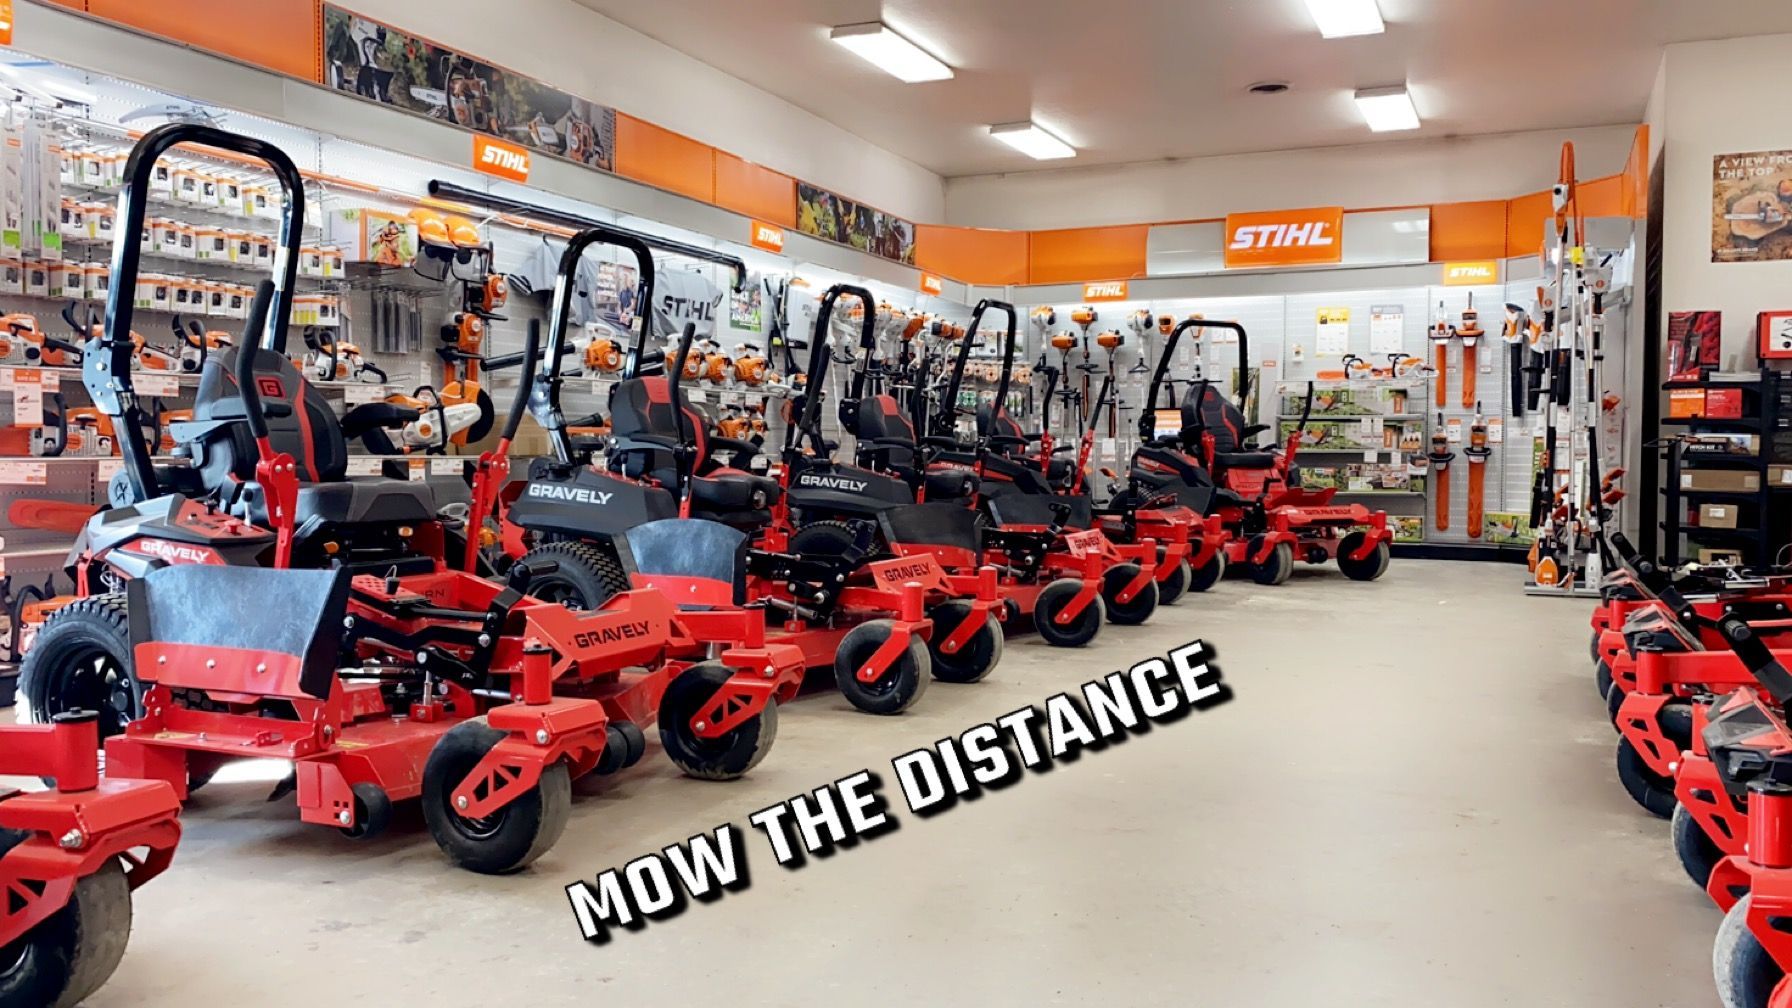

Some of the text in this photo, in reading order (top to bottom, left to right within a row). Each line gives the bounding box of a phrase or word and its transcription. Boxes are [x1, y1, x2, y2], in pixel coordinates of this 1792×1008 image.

[482, 145, 529, 174] STIHL
[1719, 160, 1728, 169] A
[1731, 156, 1766, 168] VIEW
[1718, 167, 1774, 179] THE TOP
[757, 227, 784, 246] STIHL
[1229, 222, 1333, 250] STIHL
[1449, 266, 1491, 278] STIHL
[1086, 283, 1125, 297] STIHL
[661, 296, 714, 321] STIHL
[800, 475, 868, 492] GRAVELY
[528, 483, 613, 505] GRAVELY
[141, 541, 210, 562] GRAVELY
[884, 562, 931, 582] GRAVELY
[574, 621, 650, 648] GRAVELY
